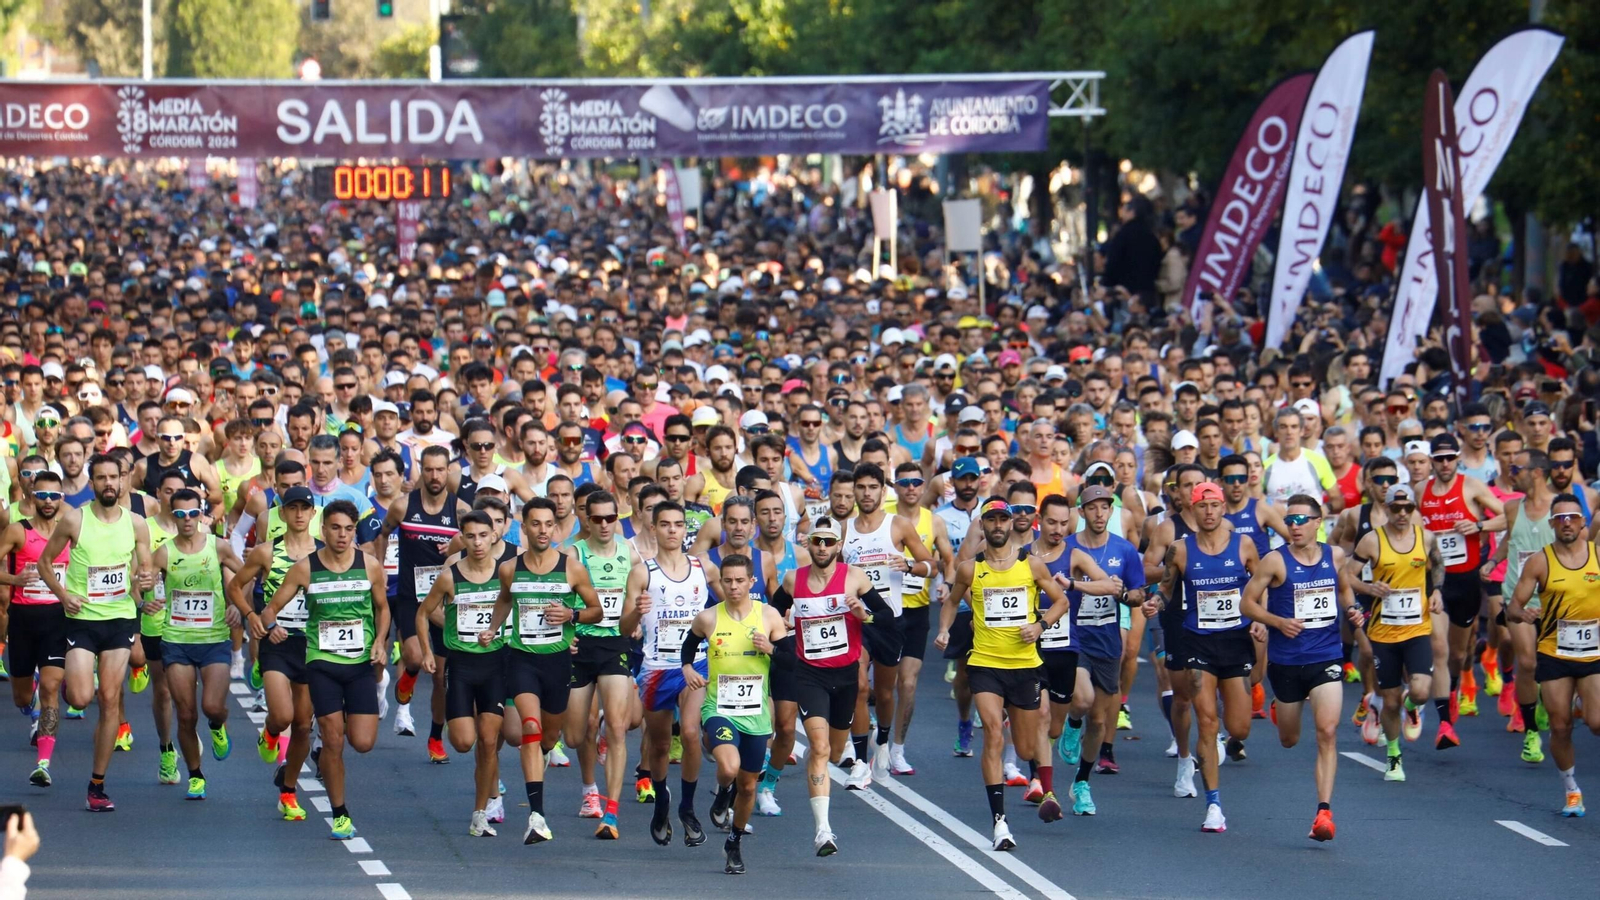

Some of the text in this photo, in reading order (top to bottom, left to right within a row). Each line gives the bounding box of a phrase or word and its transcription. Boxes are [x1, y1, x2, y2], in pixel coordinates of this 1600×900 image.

[148, 97, 203, 116] MEDIA
[570, 99, 624, 118] MEDIA
[929, 94, 1039, 117] AYUNTAMIENTO
[0, 103, 90, 130] DECO
[116, 109, 148, 134] 38
[148, 109, 238, 133] MARATÓN
[276, 98, 484, 145] SALIDA
[538, 111, 570, 136] 38
[570, 111, 656, 135] MARATÓN
[731, 103, 848, 130] IMDECO
[929, 114, 949, 136] DE
[207, 134, 238, 149] 2024
[627, 136, 657, 150] 2024
[1201, 115, 1289, 289] IMDECO
[1442, 537, 1457, 549] 55
[102, 571, 123, 585] 403
[1191, 576, 1238, 587] TROTASIERRA
[1293, 578, 1336, 590] TROTASIERRA
[184, 599, 208, 611] 173
[603, 596, 618, 609] 57
[1002, 596, 1018, 609] 62
[1094, 596, 1109, 609] 32
[1217, 599, 1233, 611] 28
[1313, 596, 1329, 609] 26
[1399, 597, 1413, 609] 17
[476, 612, 492, 625] 23
[657, 608, 690, 620] LÁZARO
[338, 628, 354, 641] 21
[820, 625, 837, 639] 64
[1576, 628, 1592, 641] 16
[737, 684, 754, 697] 37
